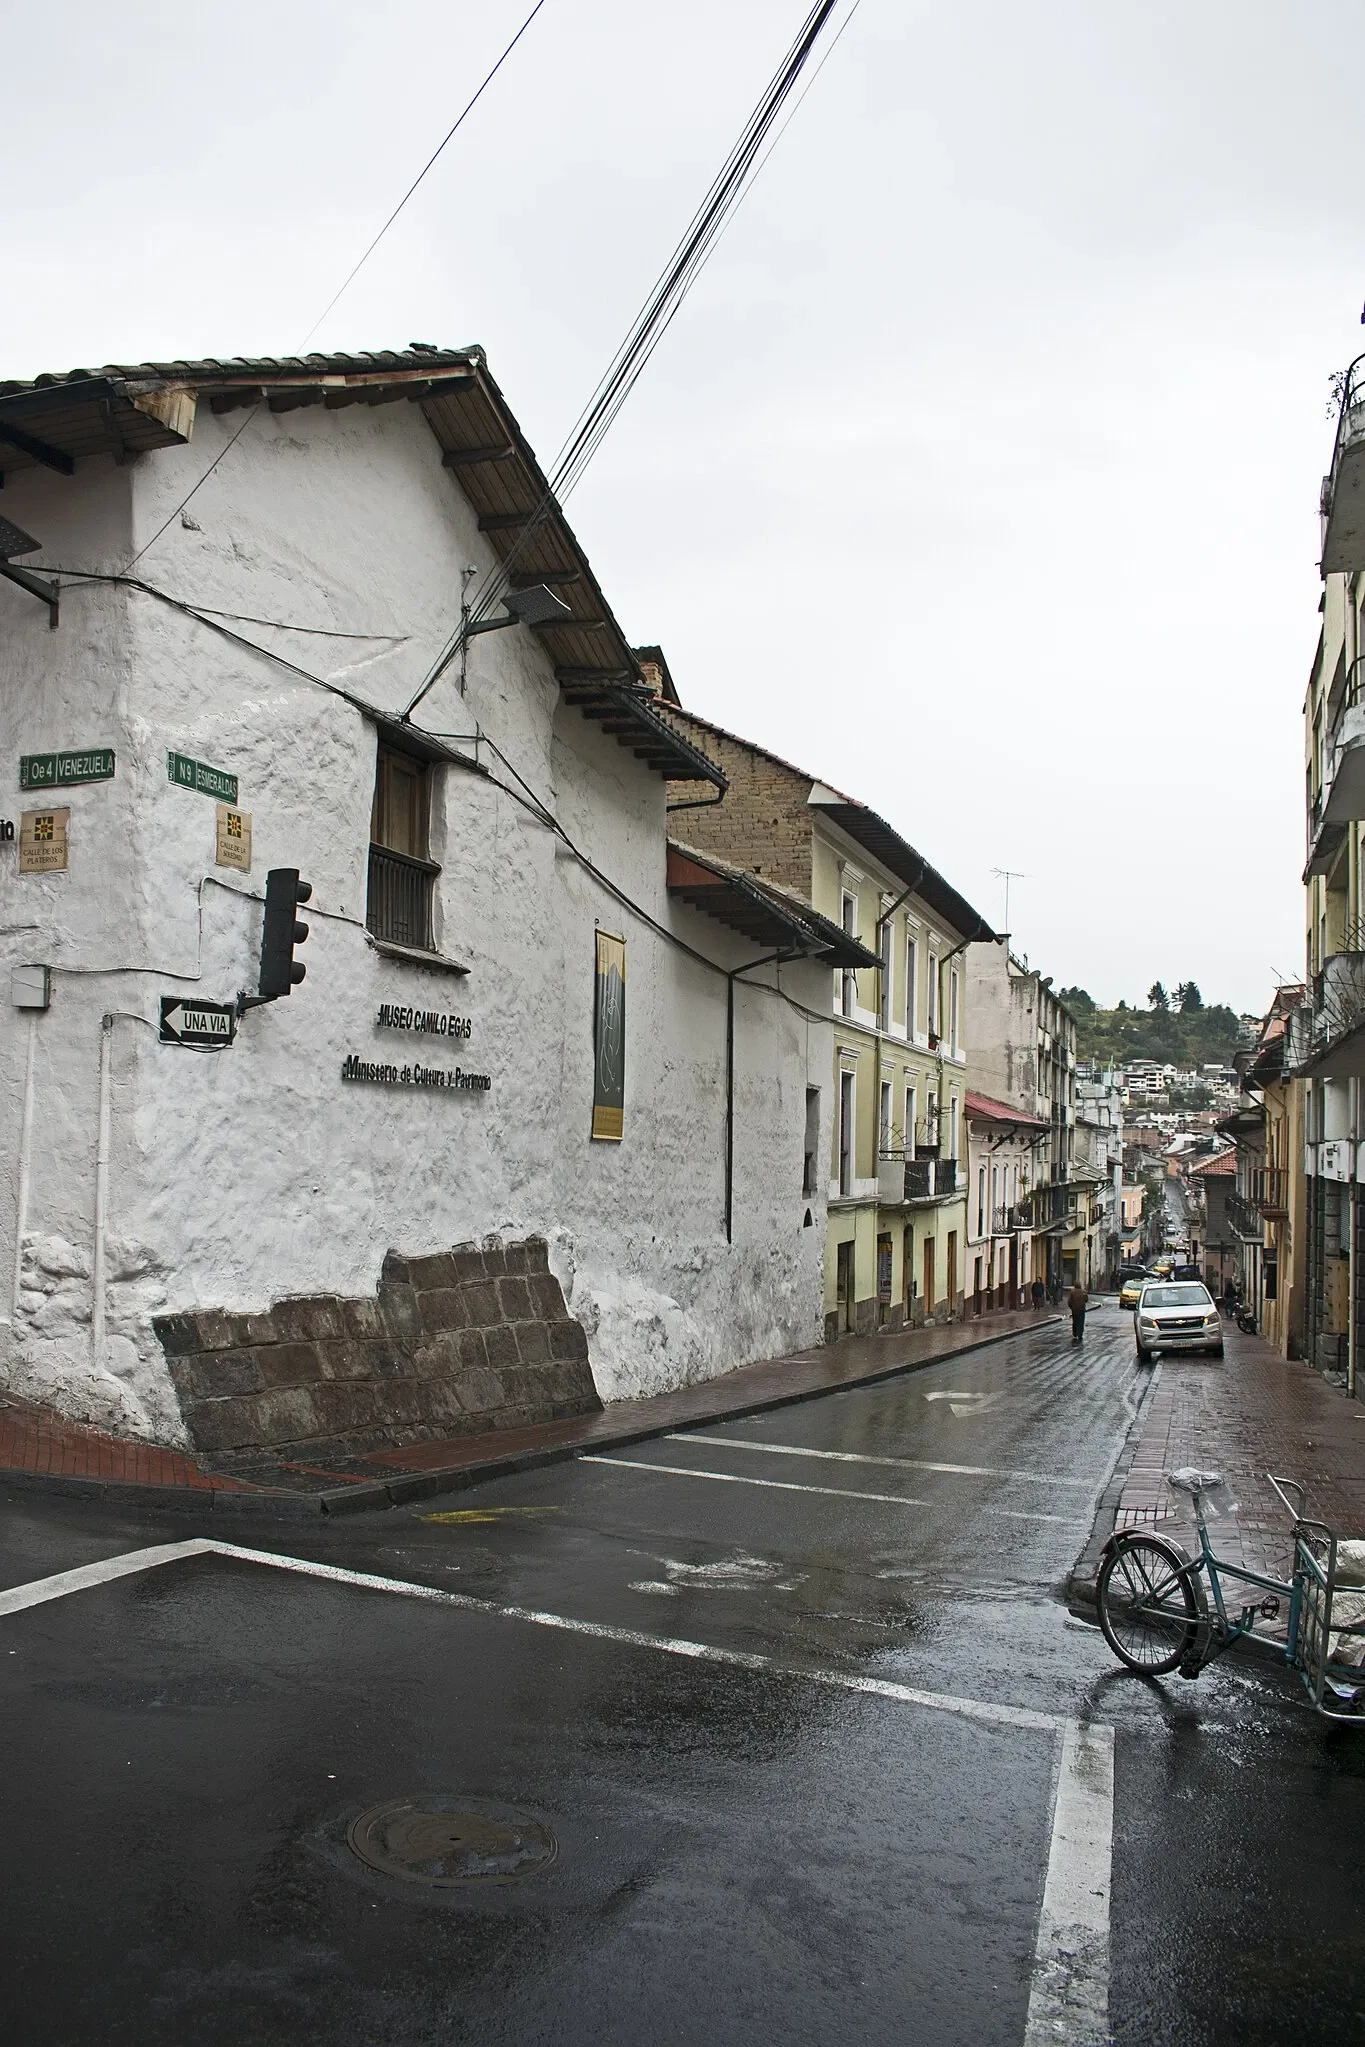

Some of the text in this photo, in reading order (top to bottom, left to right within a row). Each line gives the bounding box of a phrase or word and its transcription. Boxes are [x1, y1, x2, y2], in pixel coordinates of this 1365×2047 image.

[58, 755, 114, 777] VENEZUELA
[197, 769, 237, 798] ESMERALDAS
[22, 846, 63, 856] CALLE DE LOS
[220, 841, 234, 851] CALLE
[223, 850, 243, 861] SOLEDAD
[27, 856, 58, 865] PLATEROS
[184, 1012, 227, 1032] UNA VIA
[379, 1003, 472, 1039] MUSEO CAMILO EGAS
[346, 1054, 492, 1091] Ministerio de Cultura y Patrimonio
